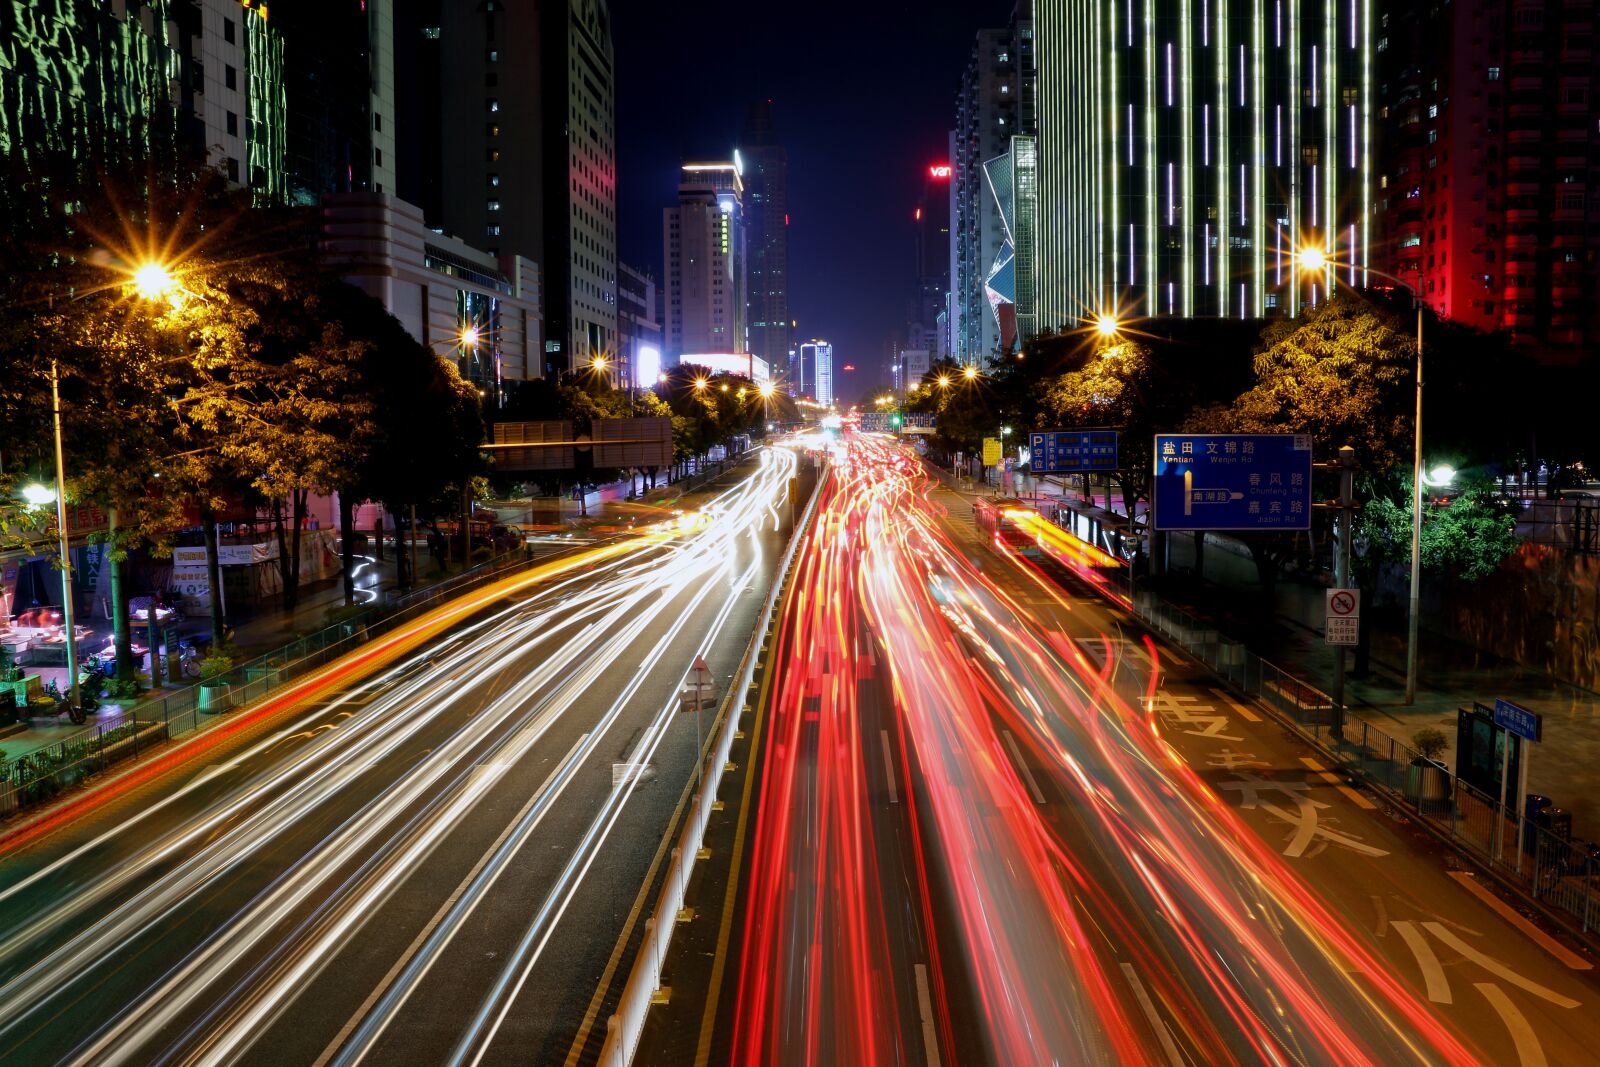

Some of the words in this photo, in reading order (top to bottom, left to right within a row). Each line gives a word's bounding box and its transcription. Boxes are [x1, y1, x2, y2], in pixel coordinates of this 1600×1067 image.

[1033, 435, 1043, 447] P
[1162, 441, 1193, 455] 盐田
[1206, 441, 1255, 455] 文锦路
[1034, 448, 1044, 469] 空位
[1162, 456, 1194, 464] Yantian
[1210, 456, 1237, 465] Wenjin
[1248, 472, 1304, 486] 春风路
[1193, 491, 1227, 502] 南湖路
[1248, 501, 1303, 514] 嘉宾路
[1257, 515, 1281, 523] Jiabin
[86, 543, 100, 586] 地铁入口
